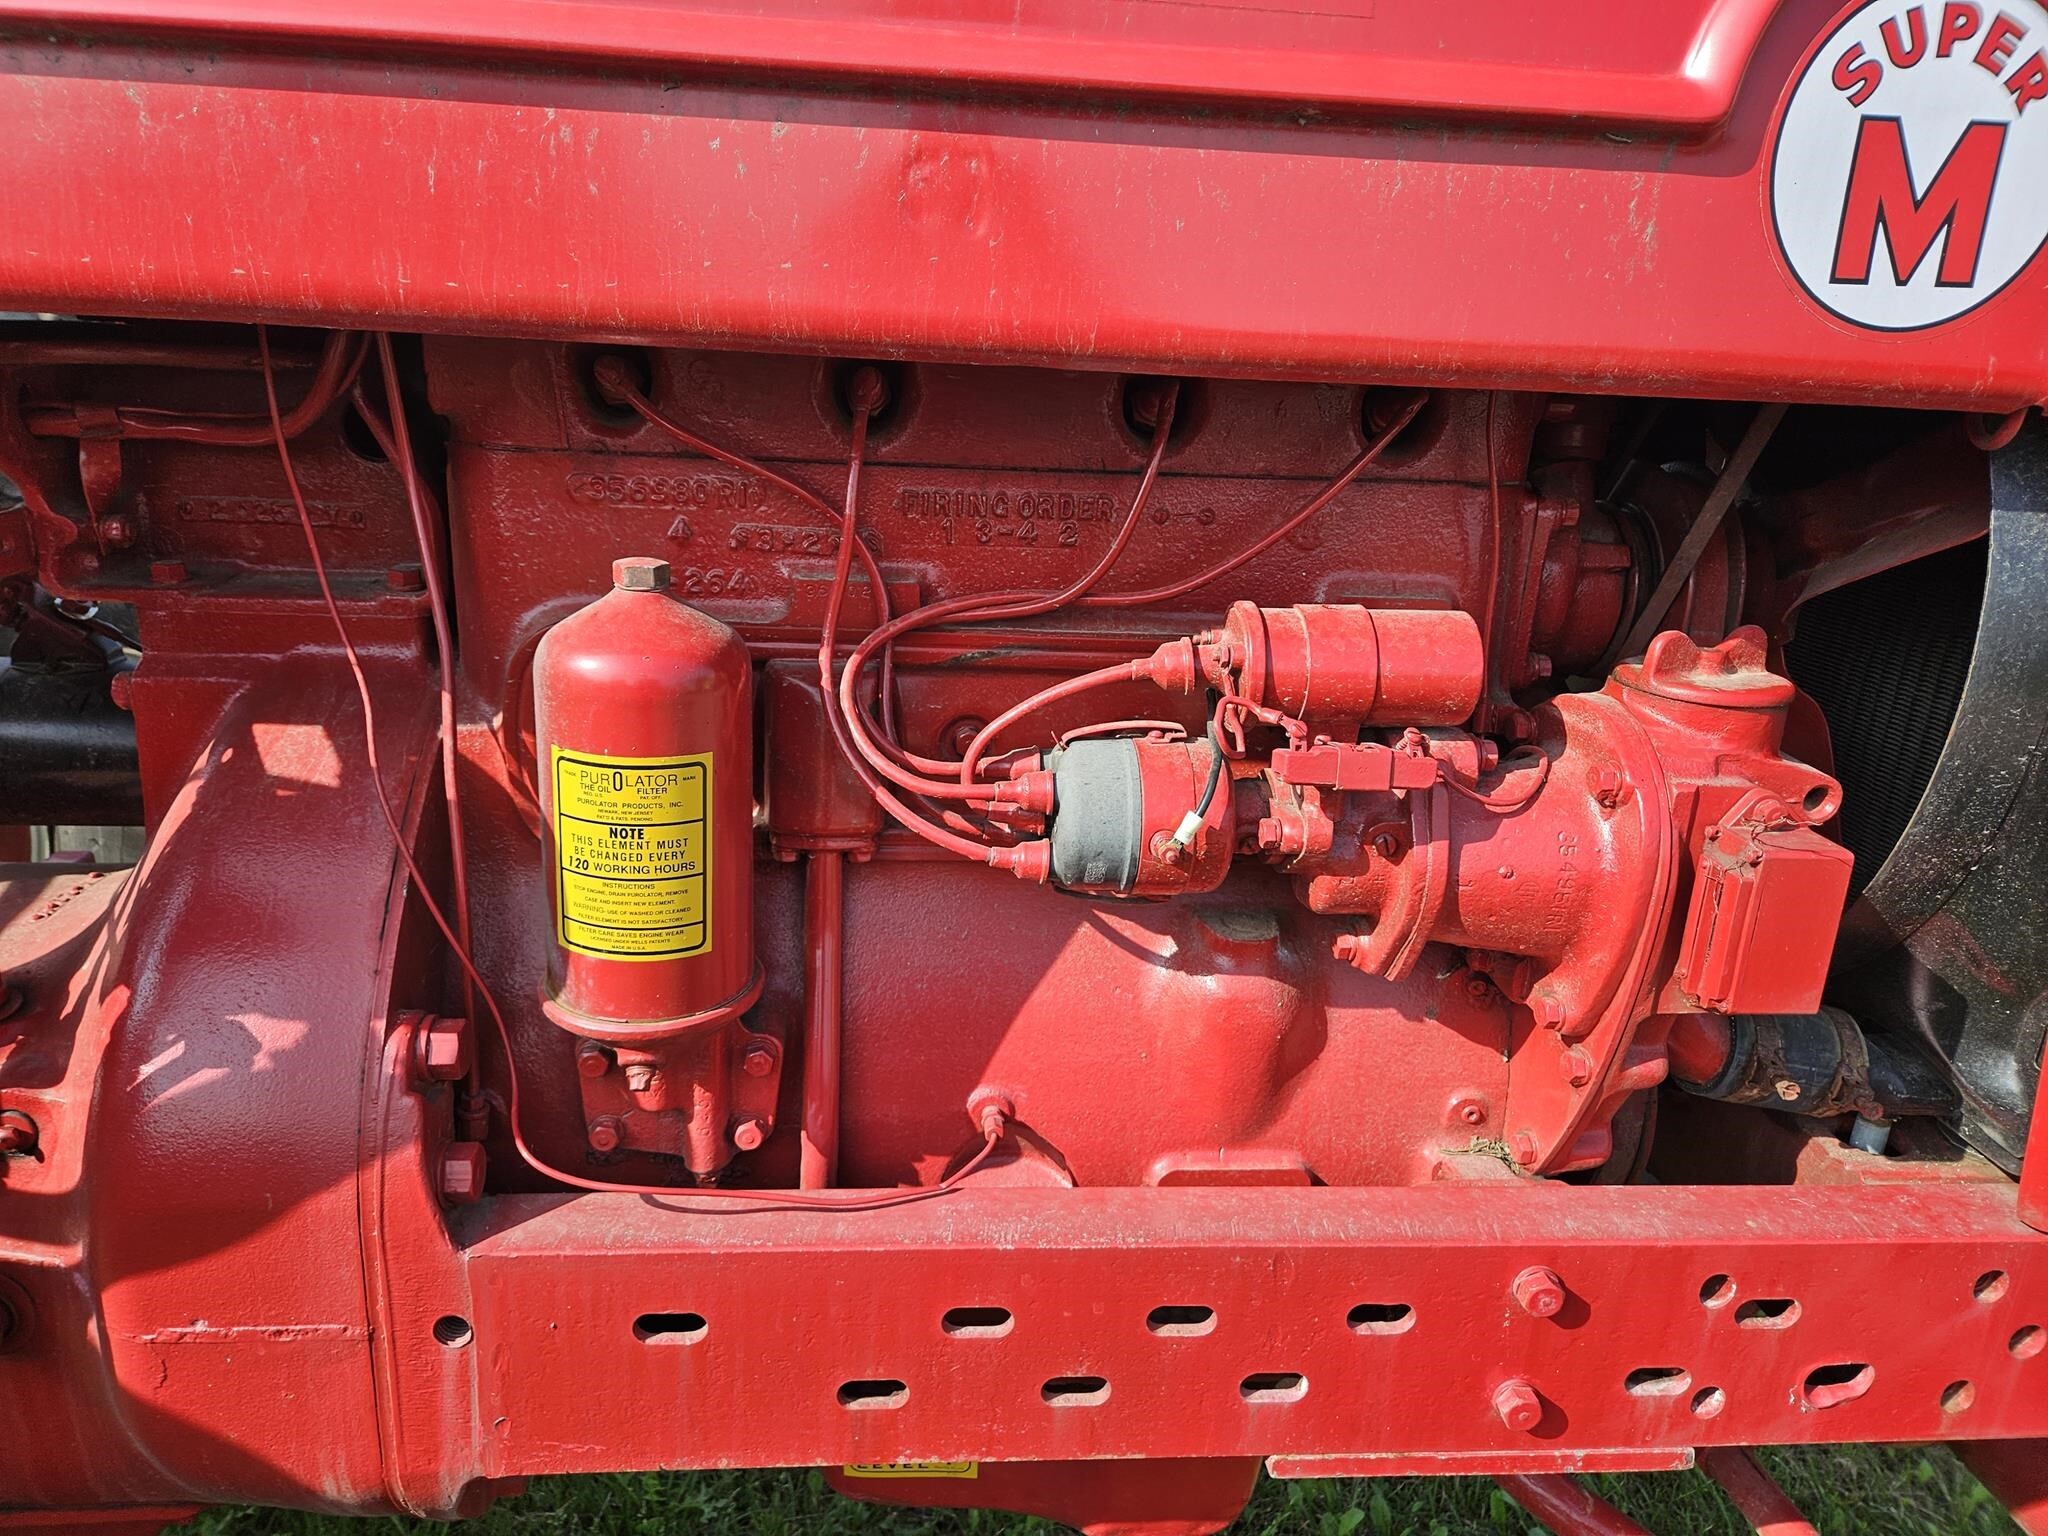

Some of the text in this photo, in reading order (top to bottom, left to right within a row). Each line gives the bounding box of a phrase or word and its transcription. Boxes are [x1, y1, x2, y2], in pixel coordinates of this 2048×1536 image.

[1831, 1, 2048, 115] SUPER
[1829, 114, 2011, 288] M
[901, 489, 1118, 521] FIRING ORDER
[580, 771, 678, 791] PUROLATOR
[580, 783, 667, 795] THE OIL FILTER
[577, 797, 618, 808] PUROLATOR
[609, 827, 644, 840] NOTE
[571, 833, 689, 850] THIS ELEMENT MUST
[575, 846, 686, 862] BE CHANGED EVERY
[569, 856, 695, 874] 120 WORKING HOURS
[602, 882, 655, 890] INSTRUCTIONS
[665, 907, 691, 915] CLEANED
[578, 913, 594, 921] FILTER
[595, 916, 620, 924] ELEMENT
[579, 926, 597, 935] FILTER
[598, 928, 615, 937] CARE
[616, 930, 637, 938] SAVES
